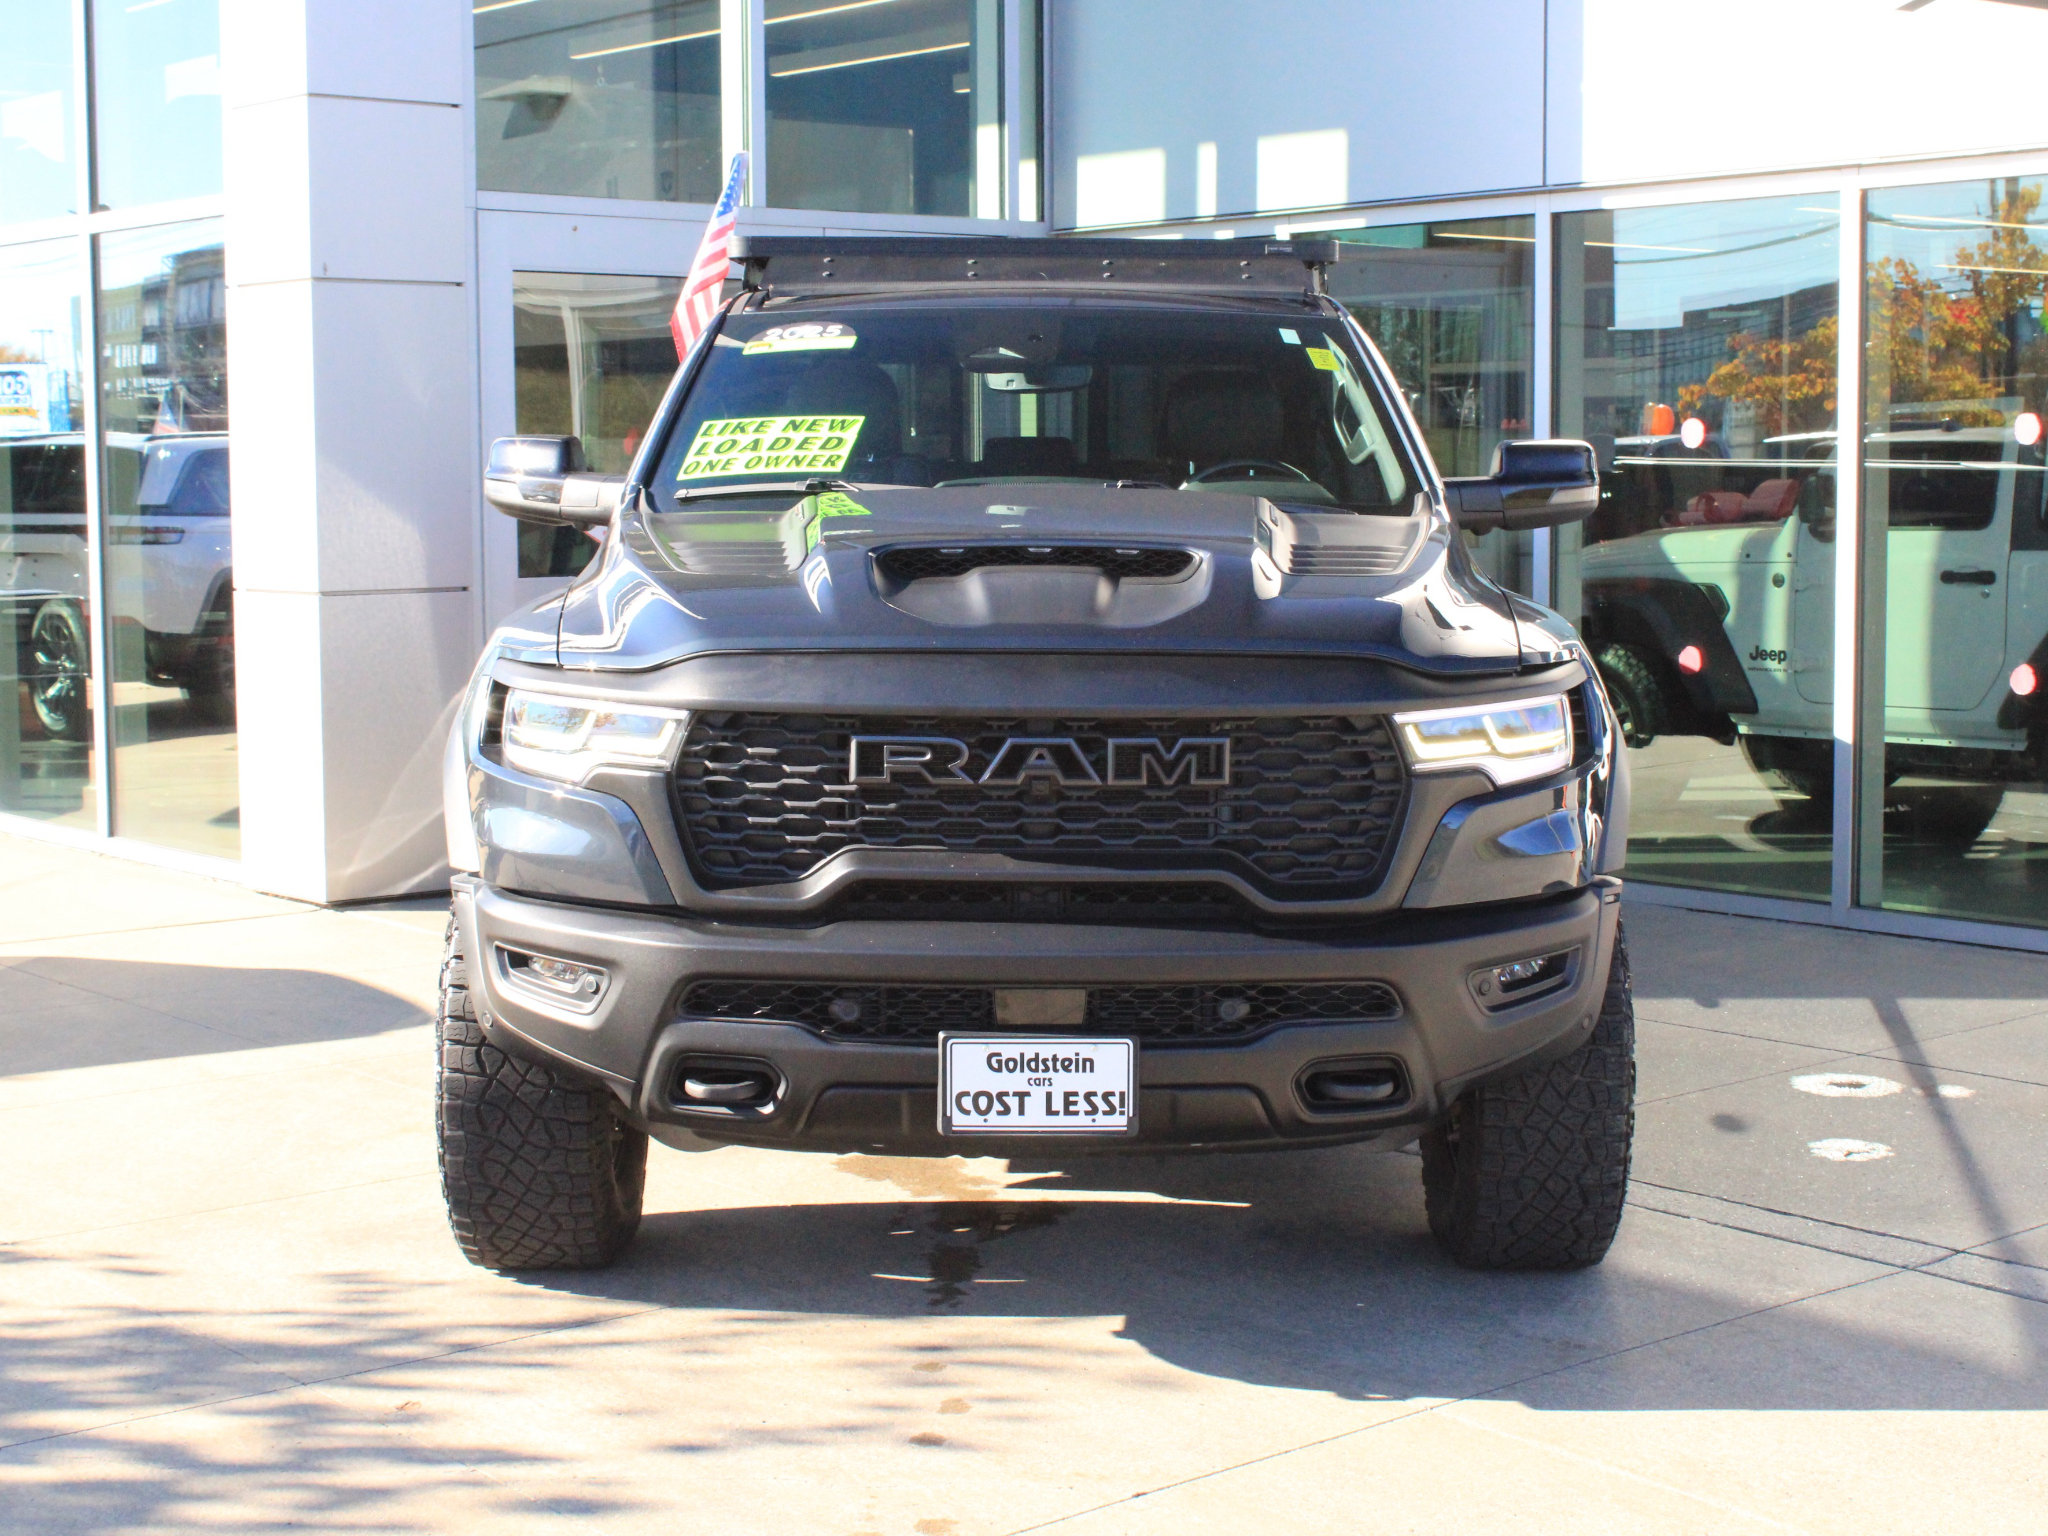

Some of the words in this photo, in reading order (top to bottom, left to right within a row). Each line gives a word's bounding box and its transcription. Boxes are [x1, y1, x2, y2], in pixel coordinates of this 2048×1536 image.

[763, 325, 843, 341] 2025
[700, 419, 776, 438] LIKE
[781, 417, 860, 434] NEW
[693, 436, 847, 457] LOADED
[683, 457, 739, 475] ONE
[744, 454, 844, 470] OWNER
[1749, 645, 1787, 665] Jeep
[849, 735, 1231, 785] RAM
[986, 1052, 1095, 1073] Goldstein
[1027, 1077, 1053, 1087] cars
[955, 1090, 1032, 1116] COST
[1045, 1090, 1126, 1116] LESS!
